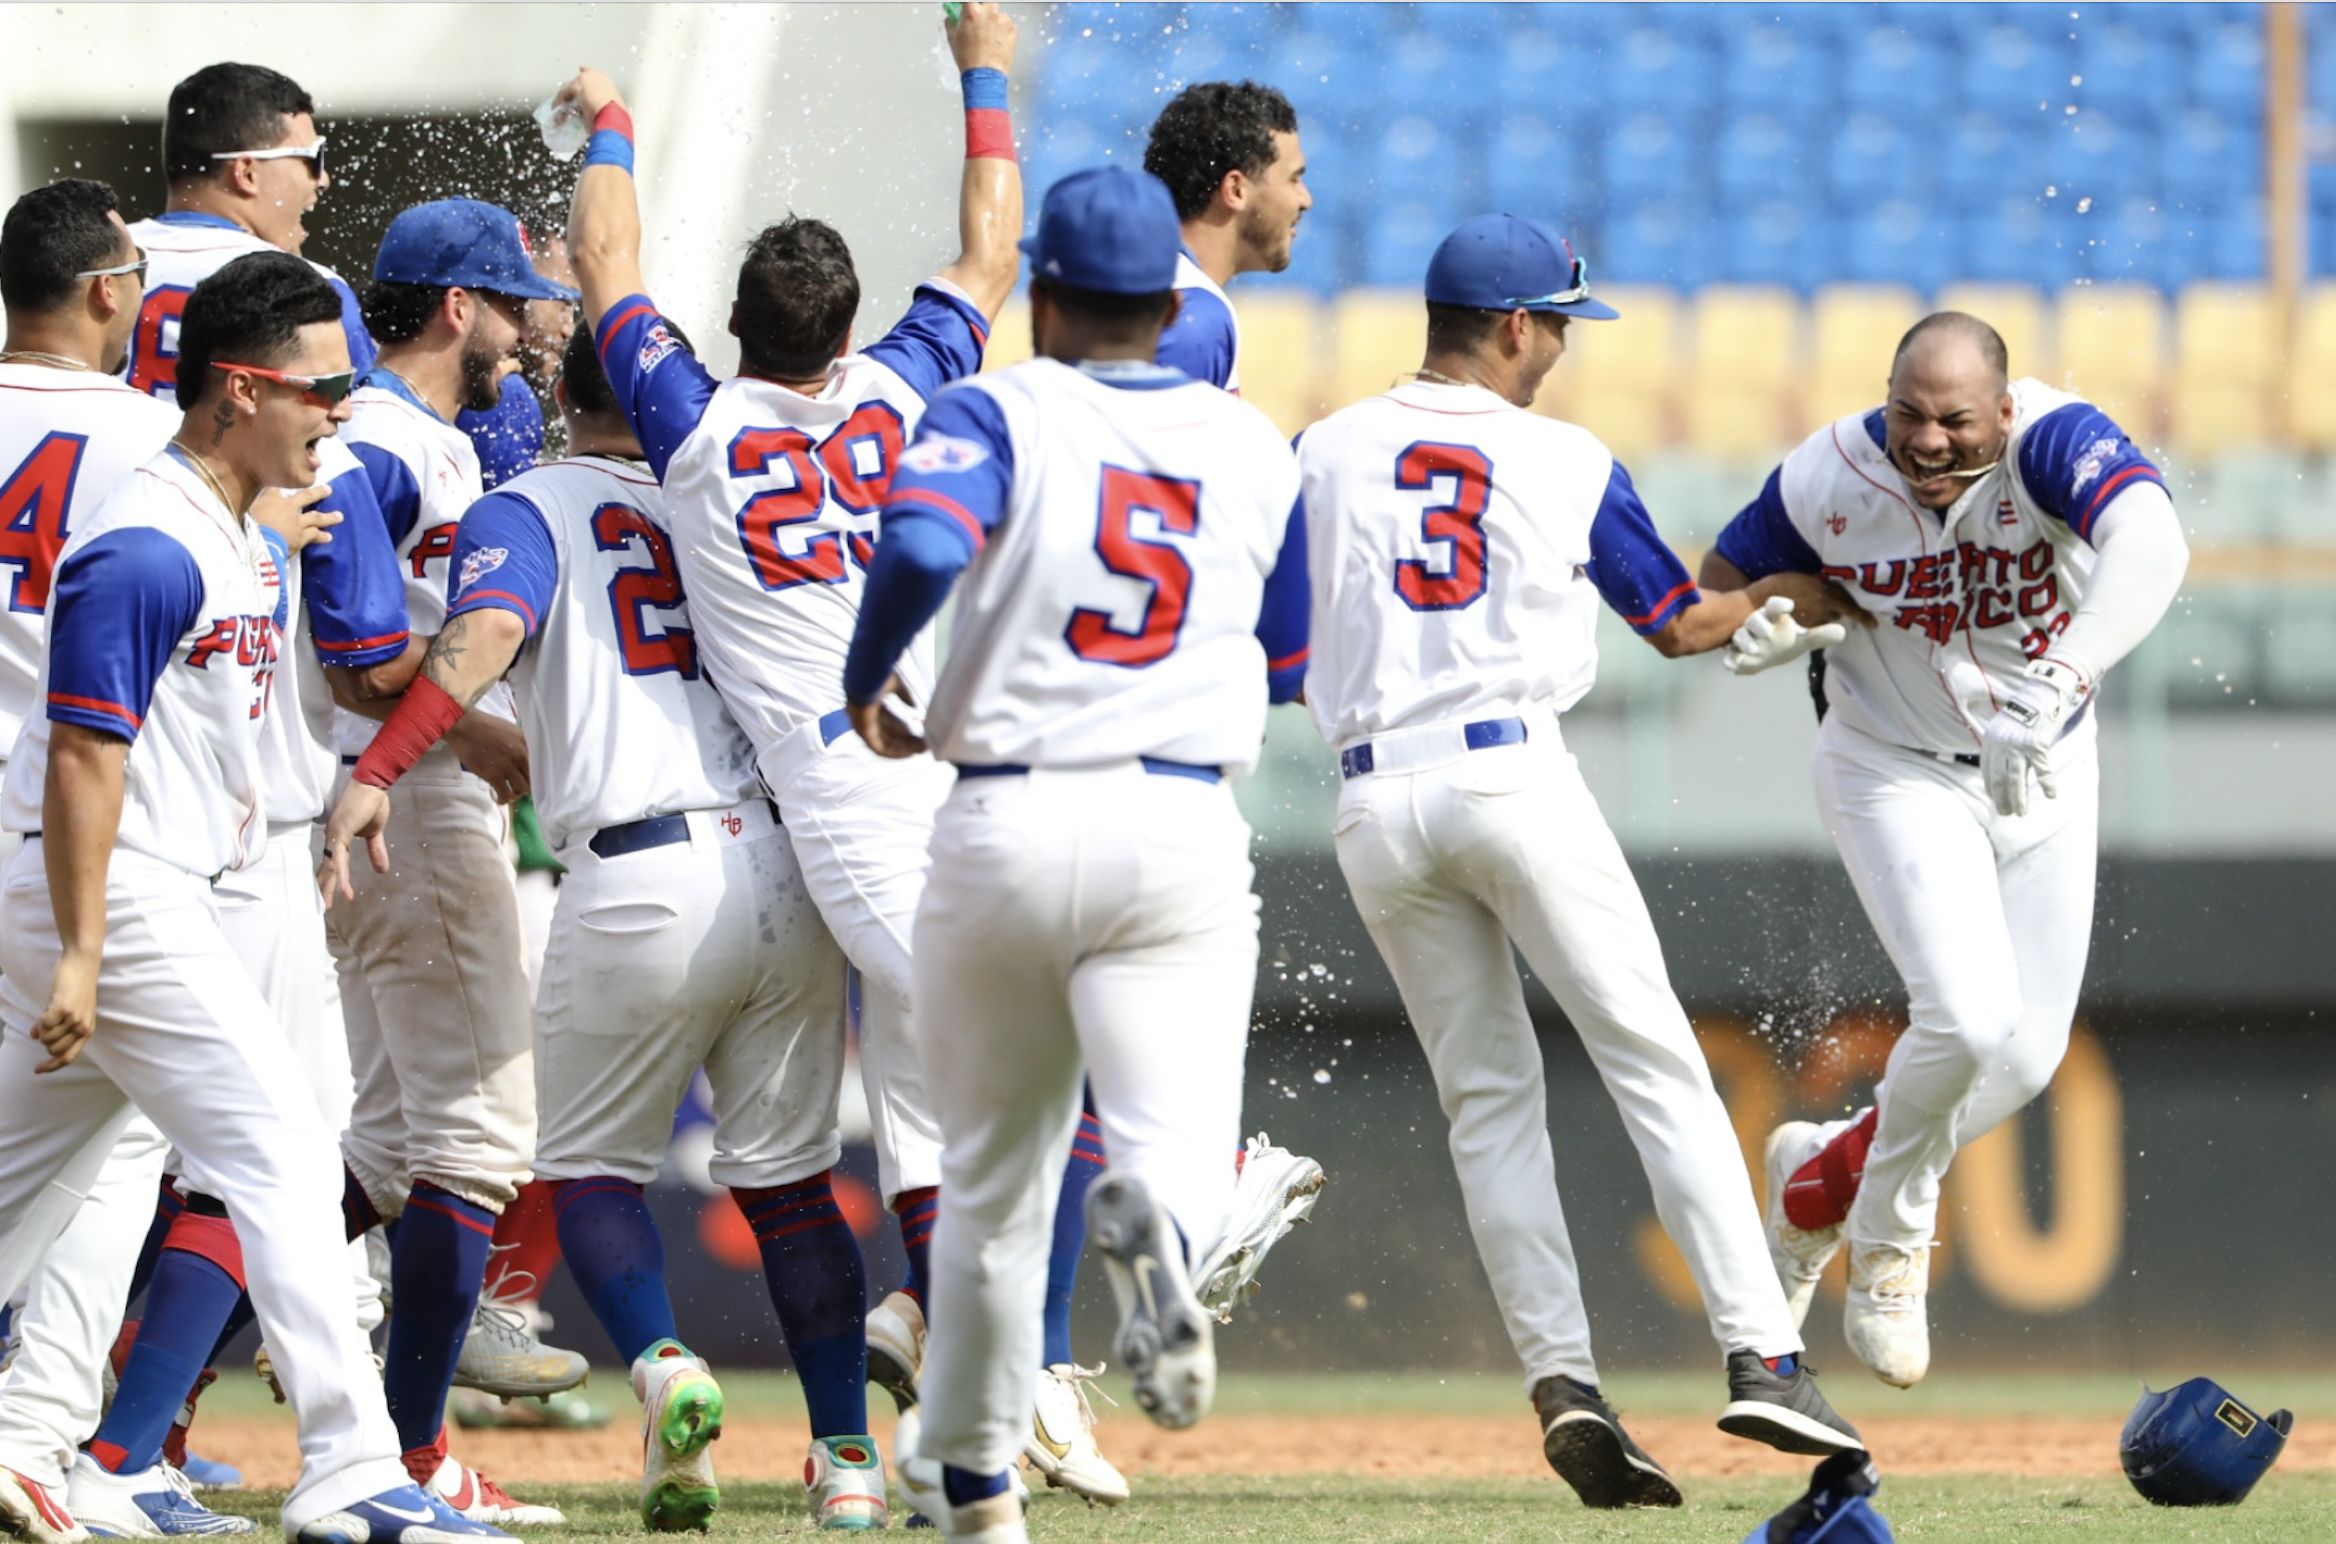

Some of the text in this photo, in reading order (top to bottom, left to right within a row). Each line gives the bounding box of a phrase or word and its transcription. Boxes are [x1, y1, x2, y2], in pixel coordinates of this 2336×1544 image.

[727, 399, 907, 592] 29
[1063, 461, 1202, 669] 5
[1393, 440, 1495, 612] 3
[1893, 573, 2057, 646] RICO
